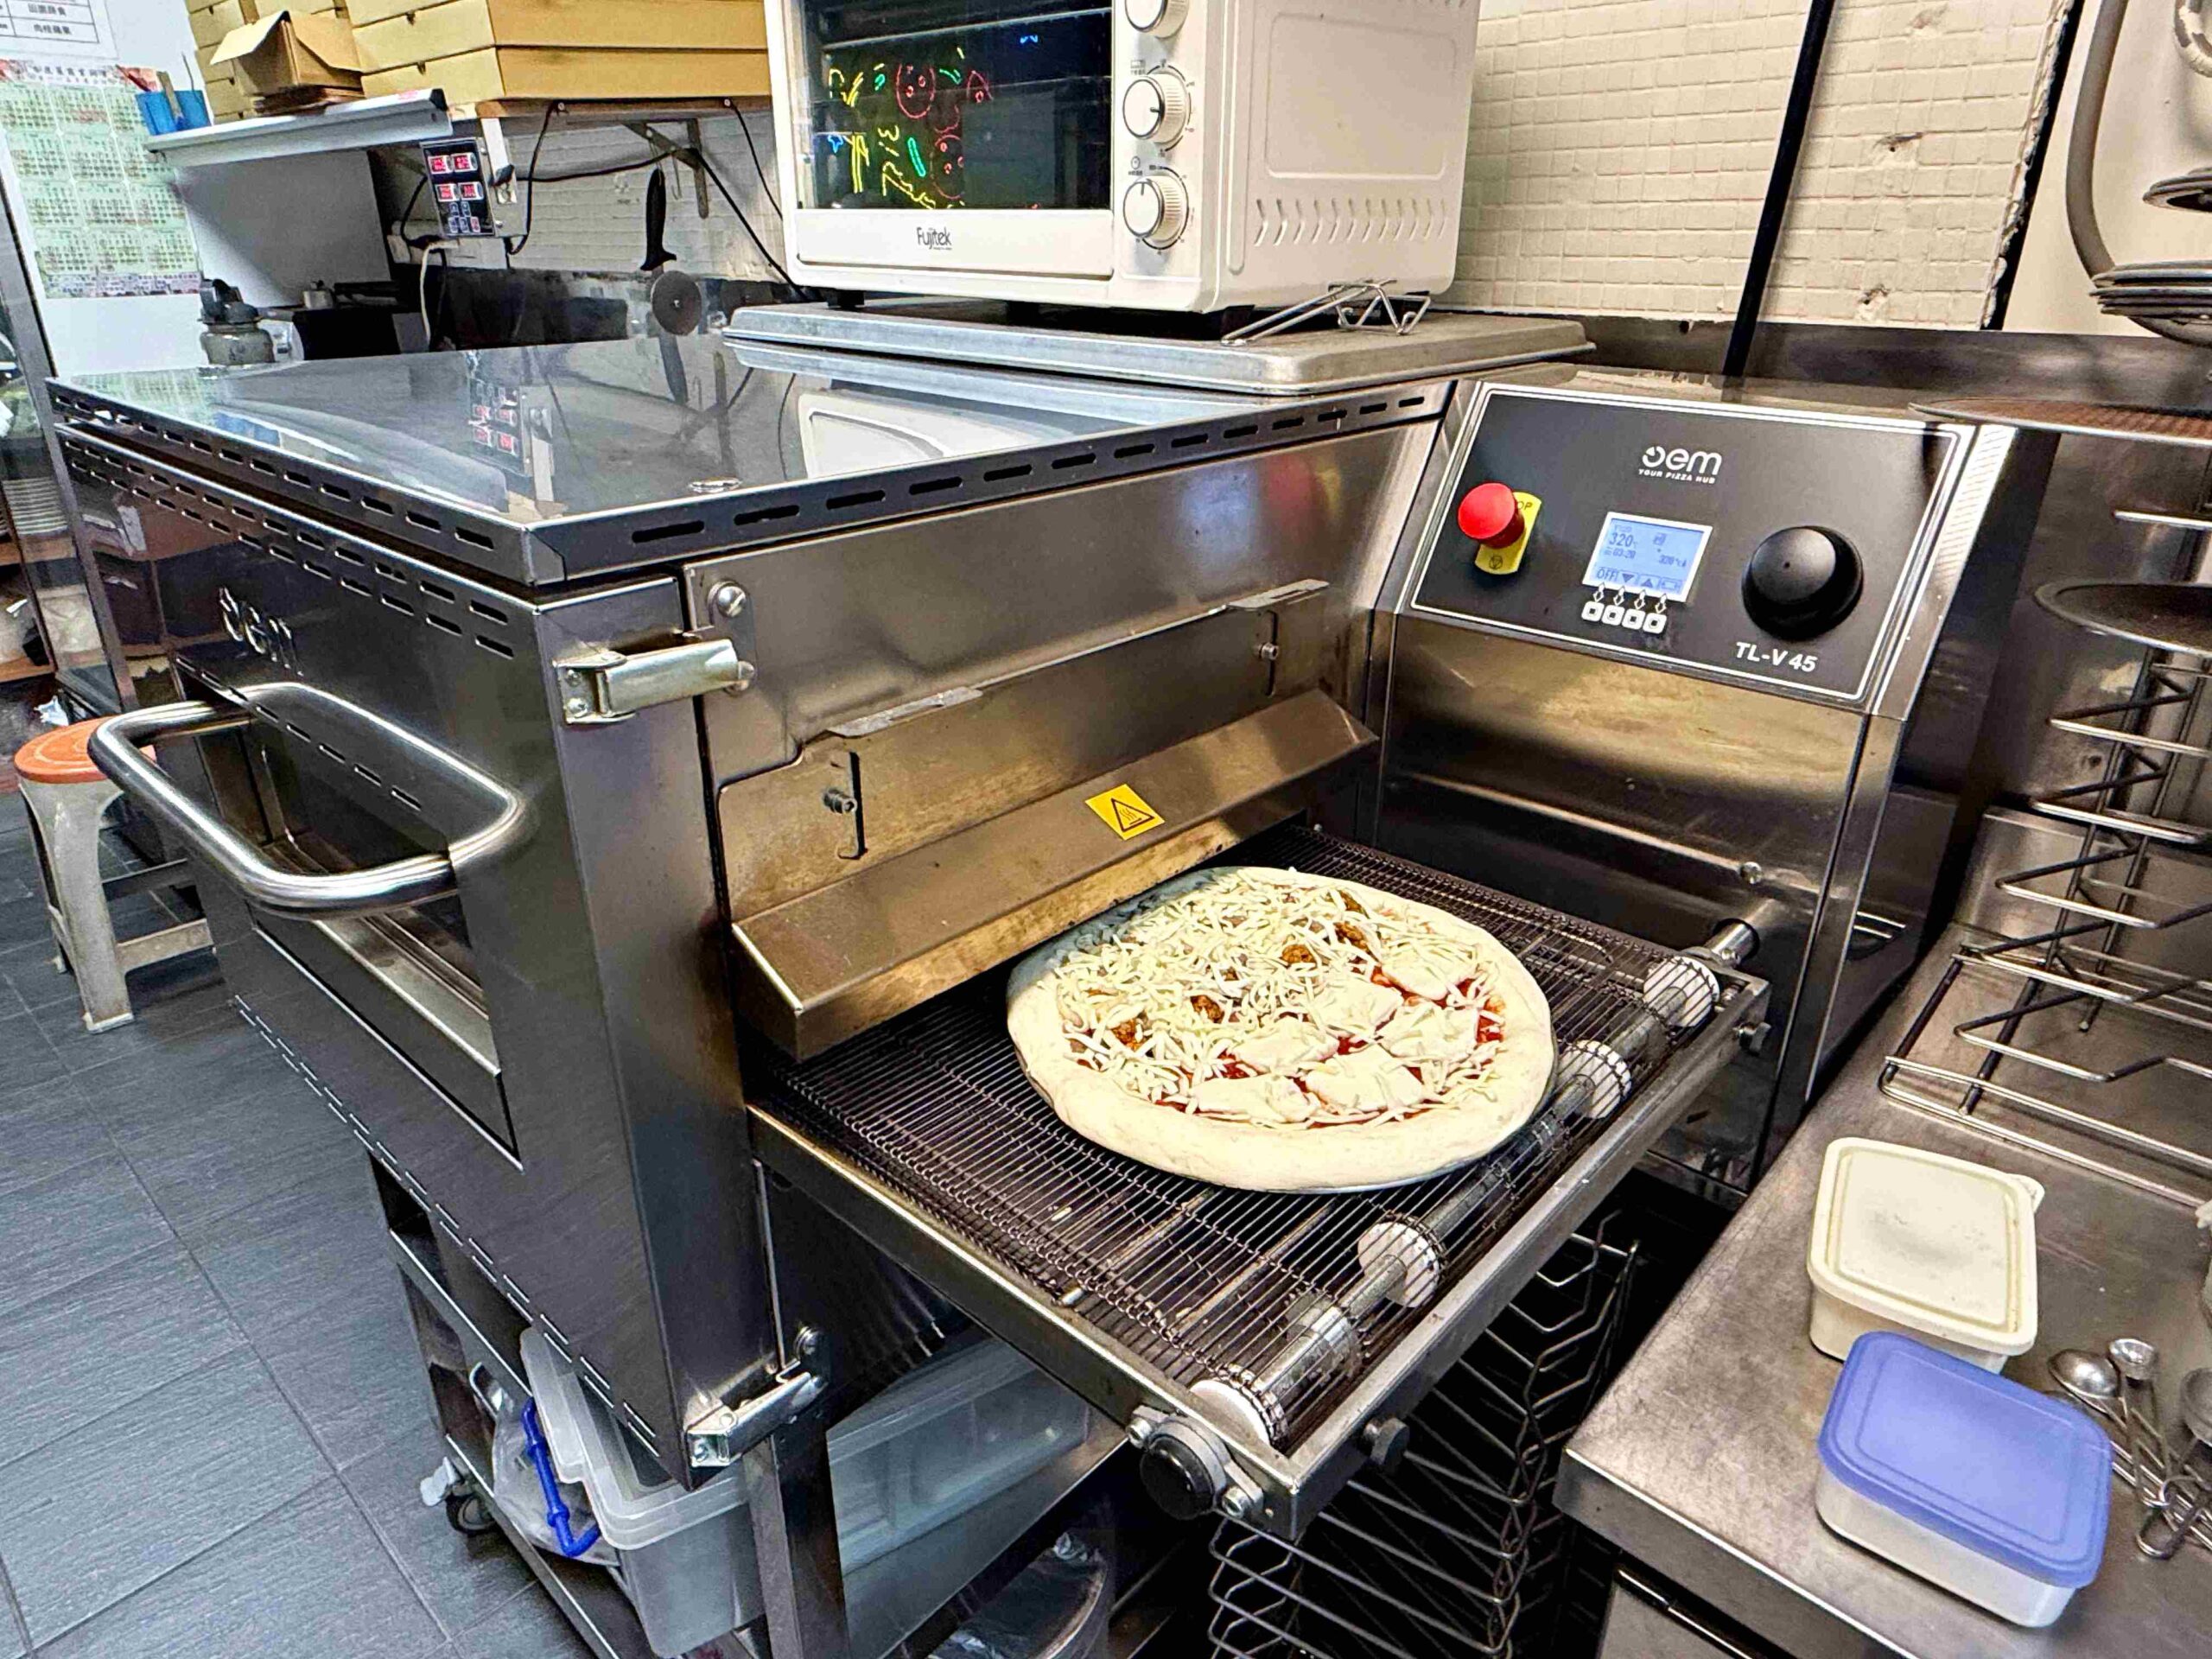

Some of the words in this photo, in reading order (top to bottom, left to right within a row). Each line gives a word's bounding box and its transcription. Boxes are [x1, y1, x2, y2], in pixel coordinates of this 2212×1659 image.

[916, 226, 952, 250] Fujitek
[1638, 468, 1663, 477] YOUR
[1665, 472, 1693, 481] PIZZA
[1597, 569, 1616, 582] OFF
[1736, 641, 1788, 666] TL-V
[1789, 653, 1818, 672] 45
